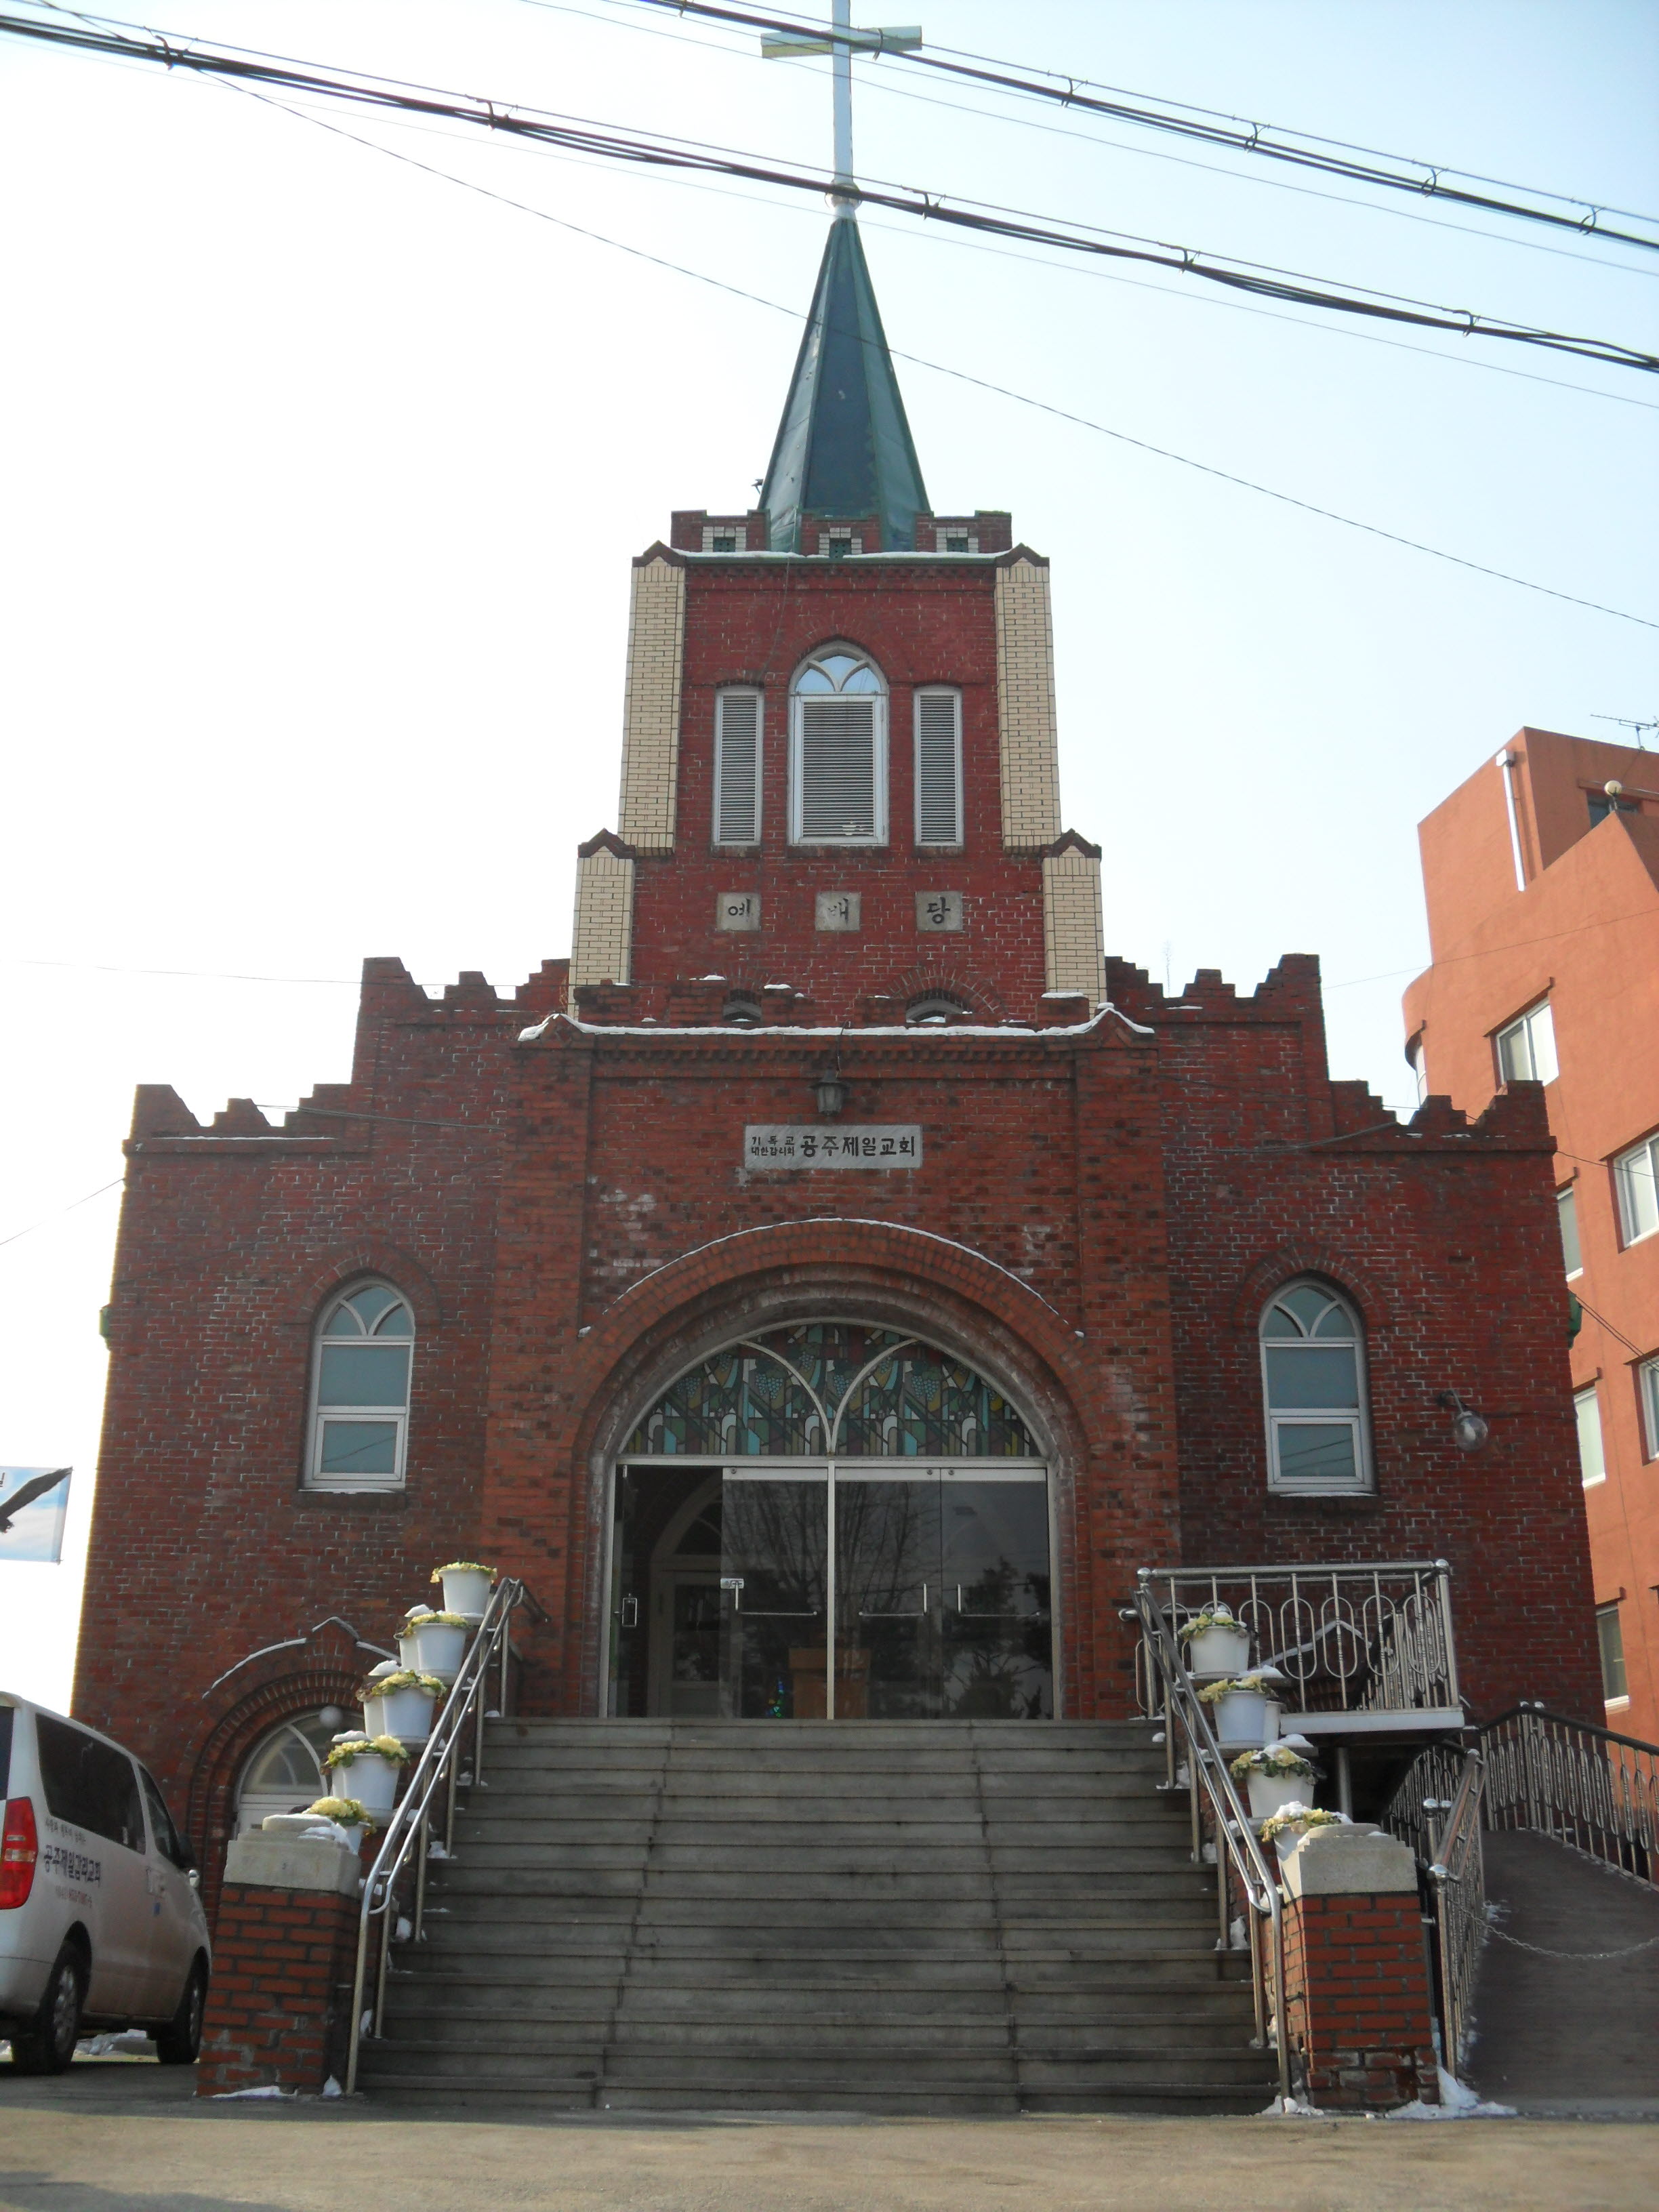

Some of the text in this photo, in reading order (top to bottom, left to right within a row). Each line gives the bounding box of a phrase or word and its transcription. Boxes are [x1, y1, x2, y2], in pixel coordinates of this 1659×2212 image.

[752, 1135, 795, 1146] 기독교
[751, 1146, 795, 1156] 대한감리회
[800, 1135, 915, 1158] 공주제일교회
